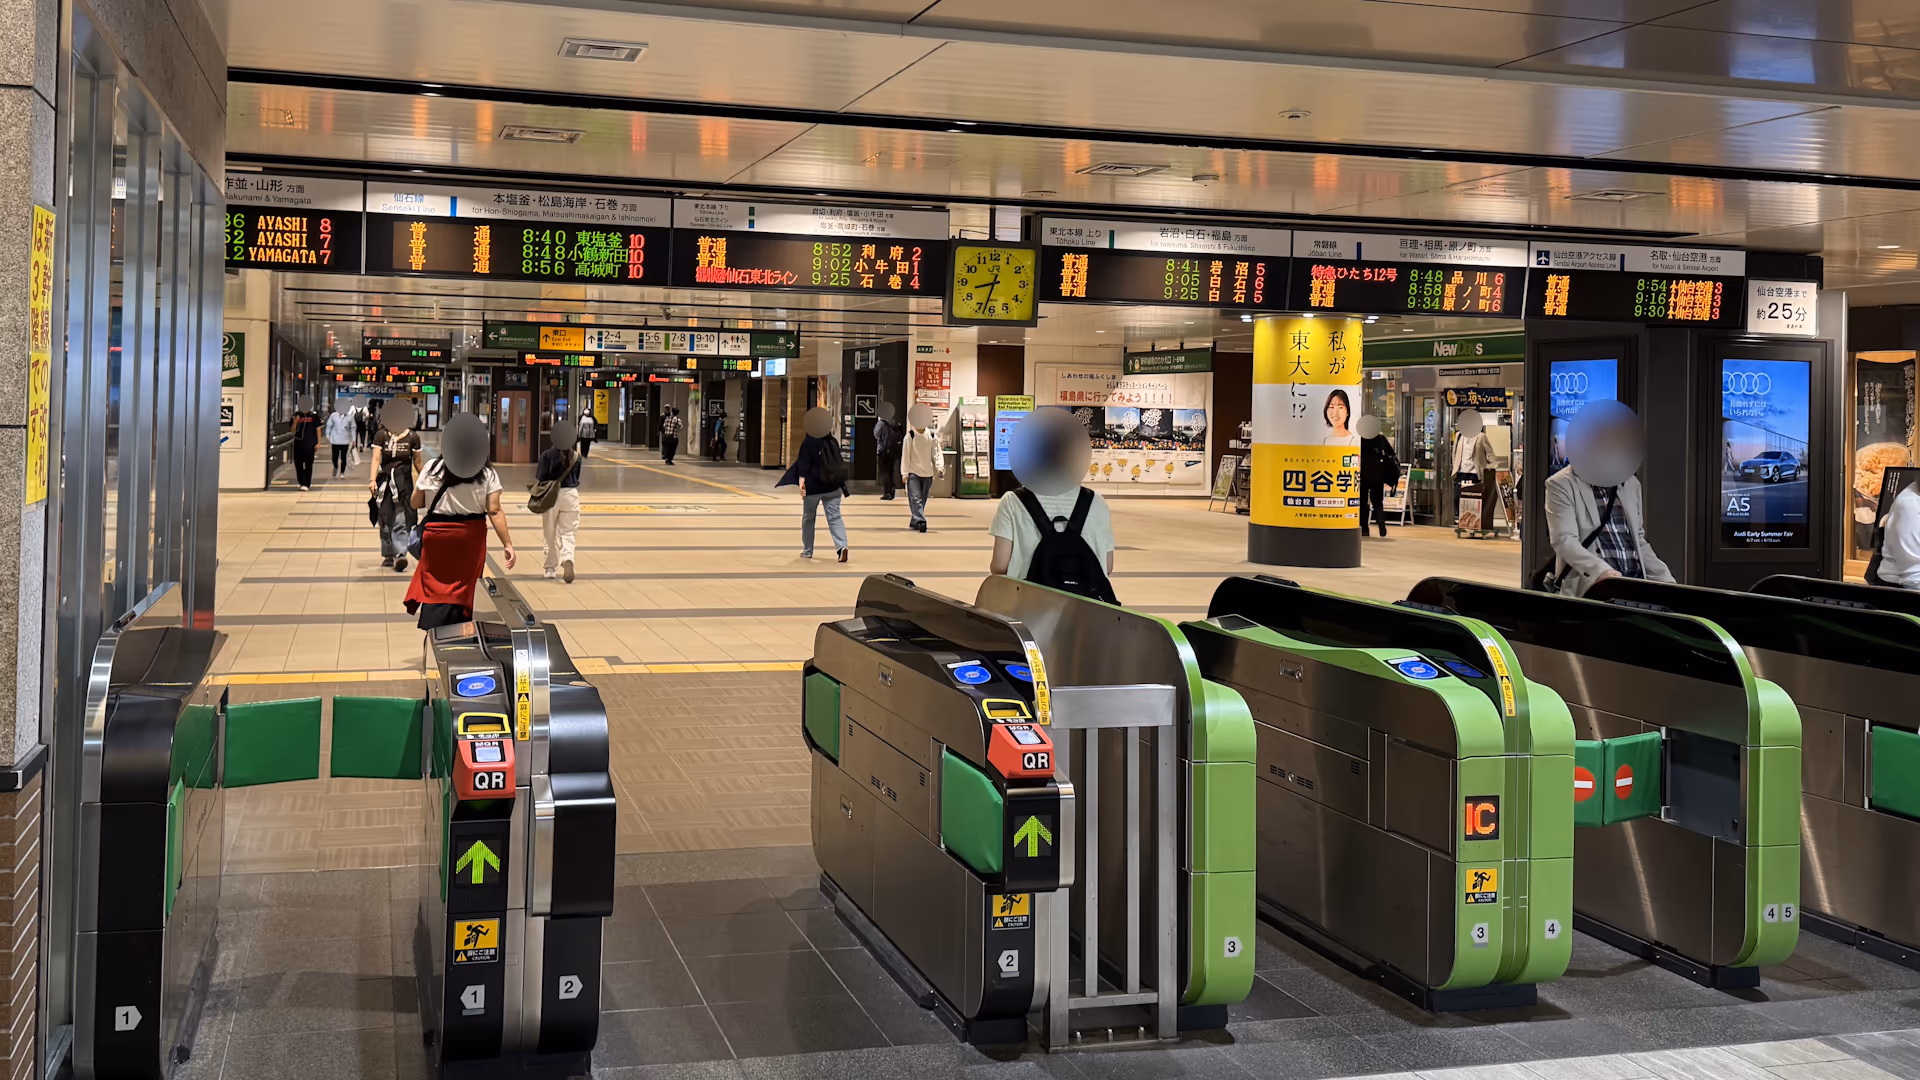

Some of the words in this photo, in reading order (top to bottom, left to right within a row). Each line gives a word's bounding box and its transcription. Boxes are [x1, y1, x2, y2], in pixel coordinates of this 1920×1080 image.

[287, 184, 305, 193] 方面
[272, 195, 312, 205] Yamagata
[394, 193, 424, 204] 仙石線
[382, 203, 415, 212] Senseki
[484, 207, 540, 218] Hon-Shiogama,
[543, 210, 609, 221] Matsushimakaigan
[618, 214, 656, 223] Ishinomaki
[621, 203, 637, 213] 方面
[257, 215, 308, 232] AYASHI
[320, 218, 332, 233] 8
[522, 229, 566, 245] 8:40
[576, 231, 623, 248] 東塩釜
[629, 234, 645, 249] 10
[1049, 227, 1083, 237] 東北本線
[1086, 229, 1102, 237] 上り
[1160, 227, 1232, 241] 岩沼・白石・福島
[257, 231, 308, 248] AYASHI
[320, 234, 332, 249] 7
[1400, 238, 1477, 252] 亘理・相馬・原ノ町
[248, 247, 317, 264] YAMAGATA
[320, 250, 331, 265] 7
[522, 244, 566, 260] 8:48
[568, 244, 629, 264] 小鶴新田
[628, 249, 644, 264] 10
[697, 236, 727, 253] 普通
[812, 242, 852, 257] 8:52
[912, 247, 922, 261] 2
[1553, 250, 1616, 261] 仙台空港アクセス線
[696, 252, 727, 268] 普通
[812, 257, 851, 272] 9:02
[912, 261, 920, 275] 1
[977, 256, 987, 265] 11
[1005, 256, 1010, 265] 1
[989, 253, 1001, 261] 12
[1650, 250, 1707, 263] 名取・仙台空港
[522, 260, 565, 275] 8:56
[575, 262, 621, 278] 高城町
[628, 264, 643, 279] 10
[966, 265, 977, 274] 10
[1014, 266, 1021, 274] 2
[988, 265, 1001, 273] JR
[1061, 253, 1088, 269] 普通
[1166, 259, 1200, 272] 8:41
[1256, 263, 1265, 276] 5
[1588, 261, 1605, 269] Access
[811, 272, 851, 286] 9:25
[909, 276, 920, 290] 4
[1060, 268, 1087, 284] 普通
[1165, 273, 1200, 286] 9:05
[1255, 277, 1264, 290] 6
[1311, 264, 1398, 282] 特急ひたち12号
[1410, 269, 1443, 282] 8:48
[1494, 273, 1504, 285] 6
[961, 278, 968, 286] 9
[1018, 280, 1026, 288] 3
[1310, 278, 1336, 294] 普通
[1408, 283, 1442, 296] 8:58
[1492, 286, 1502, 298] 4
[1546, 274, 1570, 290] 普通
[1636, 279, 1667, 292] 8:54
[1715, 282, 1723, 294] 3
[966, 292, 973, 301] 8
[1012, 294, 1019, 302] 4
[1059, 283, 1086, 297] 普通
[1164, 287, 1199, 300] 9:25
[1253, 290, 1263, 303] 5
[1544, 288, 1568, 303] 普通
[1635, 292, 1666, 304] 9:16
[1713, 295, 1721, 307] 3
[1757, 286, 1808, 298] 仙台空港まで
[976, 302, 983, 311] 7
[1002, 303, 1009, 311] 5
[988, 306, 995, 314] 6
[1309, 293, 1335, 308] 普通
[1407, 296, 1440, 309] 9:34
[1491, 299, 1501, 312] 6
[1543, 302, 1567, 316] 普通
[1634, 305, 1665, 317] 9:30
[1711, 308, 1720, 319] 3
[1757, 302, 1808, 322] 約25分
[1328, 331, 1347, 375] 私が
[1726, 497, 1751, 512] A5
[1023, 752, 1049, 769] QR
[474, 772, 505, 790] QR
[1466, 803, 1496, 835] IC
[1767, 907, 1775, 919] 4
[1784, 906, 1792, 918] 5
[1477, 927, 1485, 938] 3
[1548, 923, 1556, 934] 4
[1228, 940, 1236, 953] 3
[1005, 954, 1014, 967] 2
[564, 980, 574, 994] 2
[470, 989, 477, 1004] 1
[122, 1010, 129, 1025] 1
